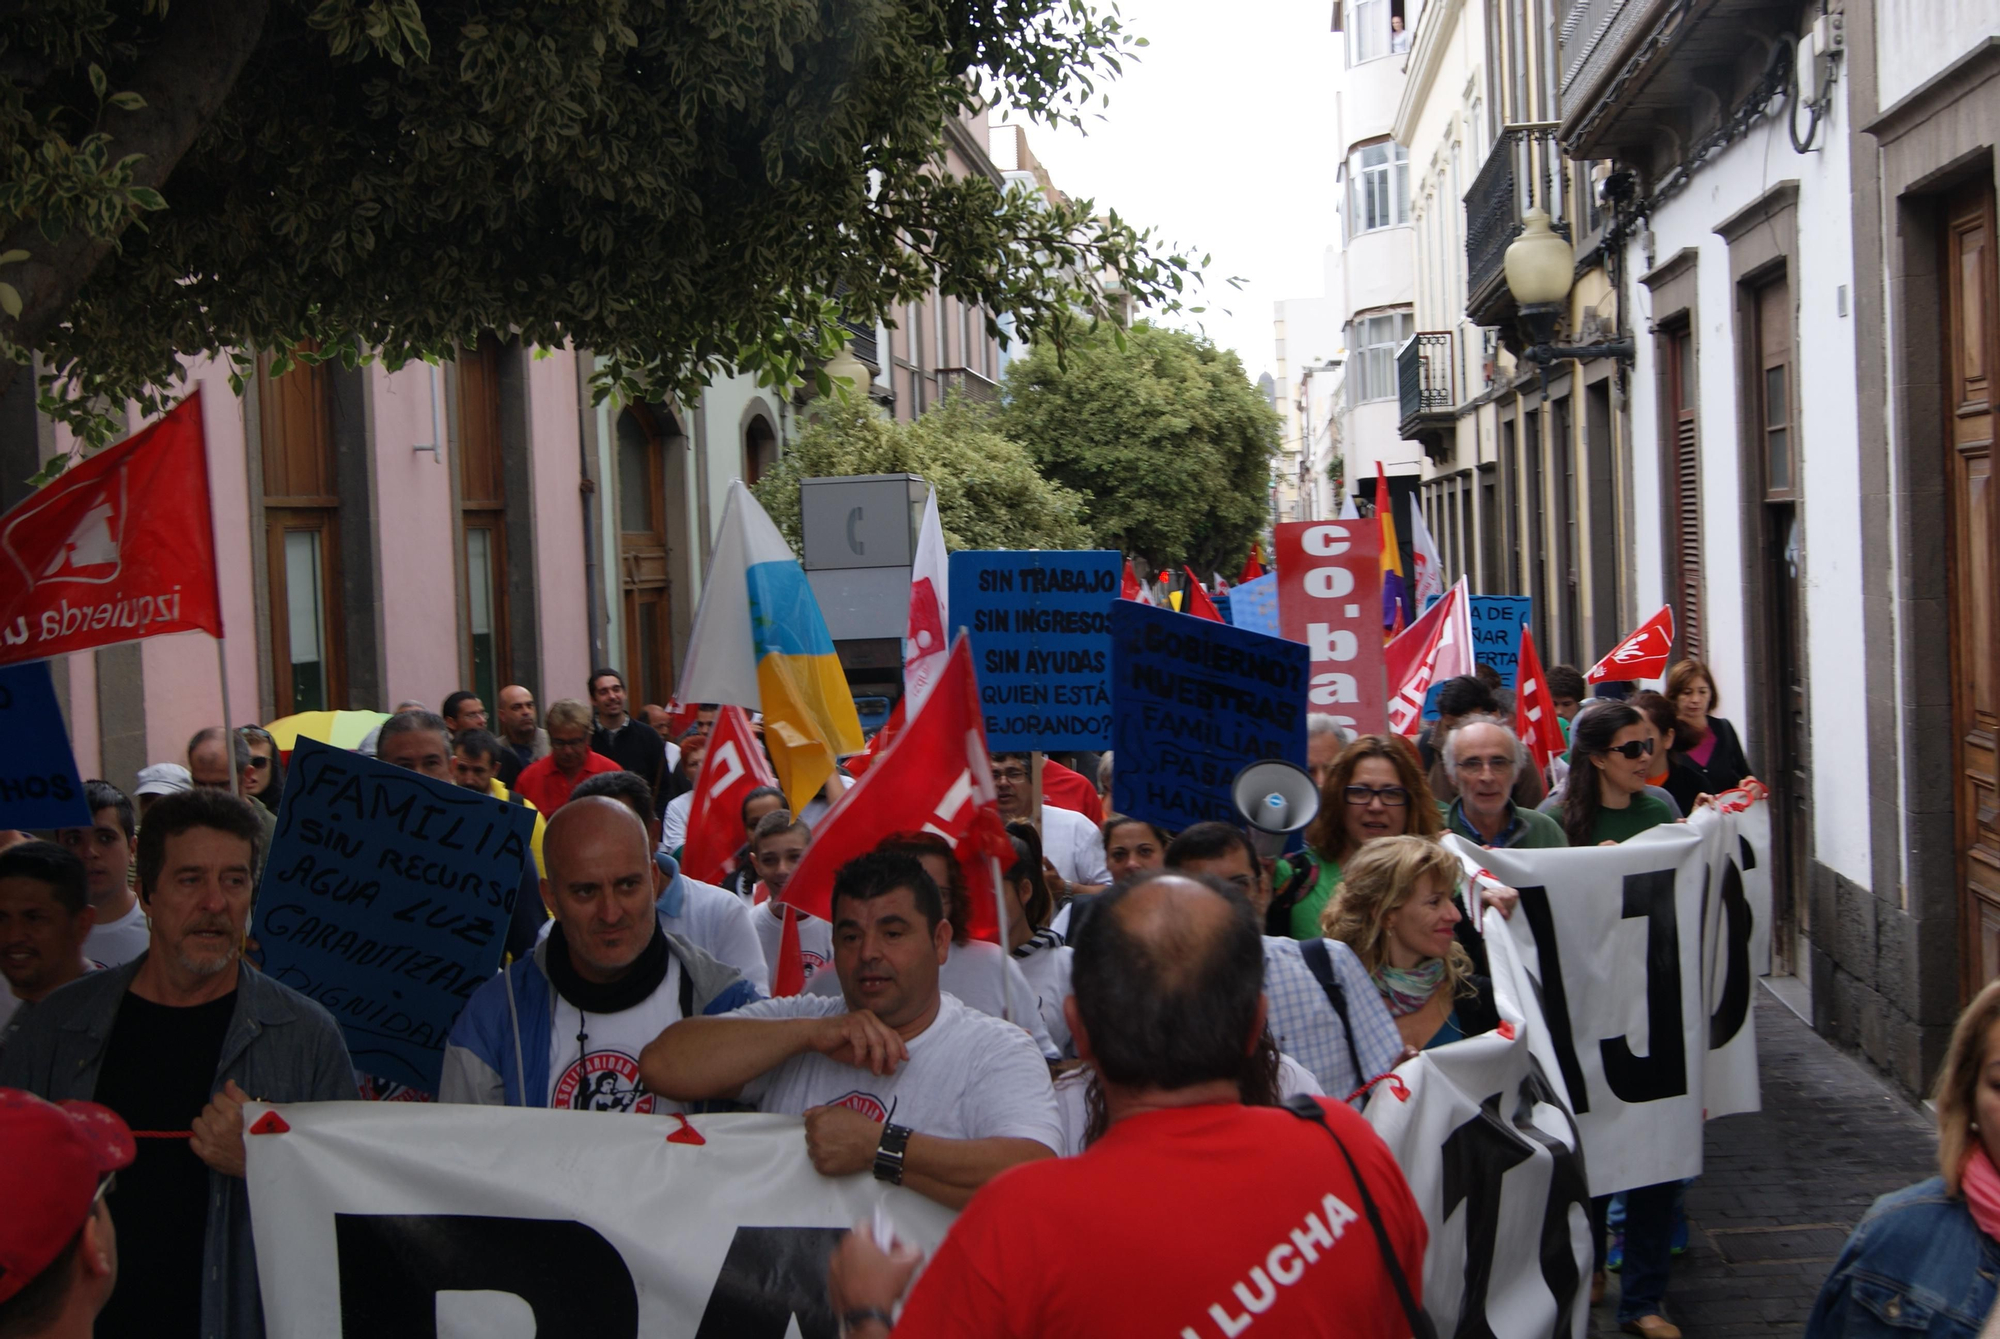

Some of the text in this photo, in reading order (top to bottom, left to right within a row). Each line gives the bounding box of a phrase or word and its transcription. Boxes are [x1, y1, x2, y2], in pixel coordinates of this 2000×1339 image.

[978, 568, 1116, 593] SIN TRABAJO
[974, 609, 1009, 633] SIN
[1488, 606, 1513, 621] DE
[985, 649, 1106, 674] SIN AYUDAS
[981, 680, 1111, 706] QUIEN ESTÁ
[278, 855, 495, 946] AGUA LUZ
[1207, 1192, 1360, 1339] LUCHA
